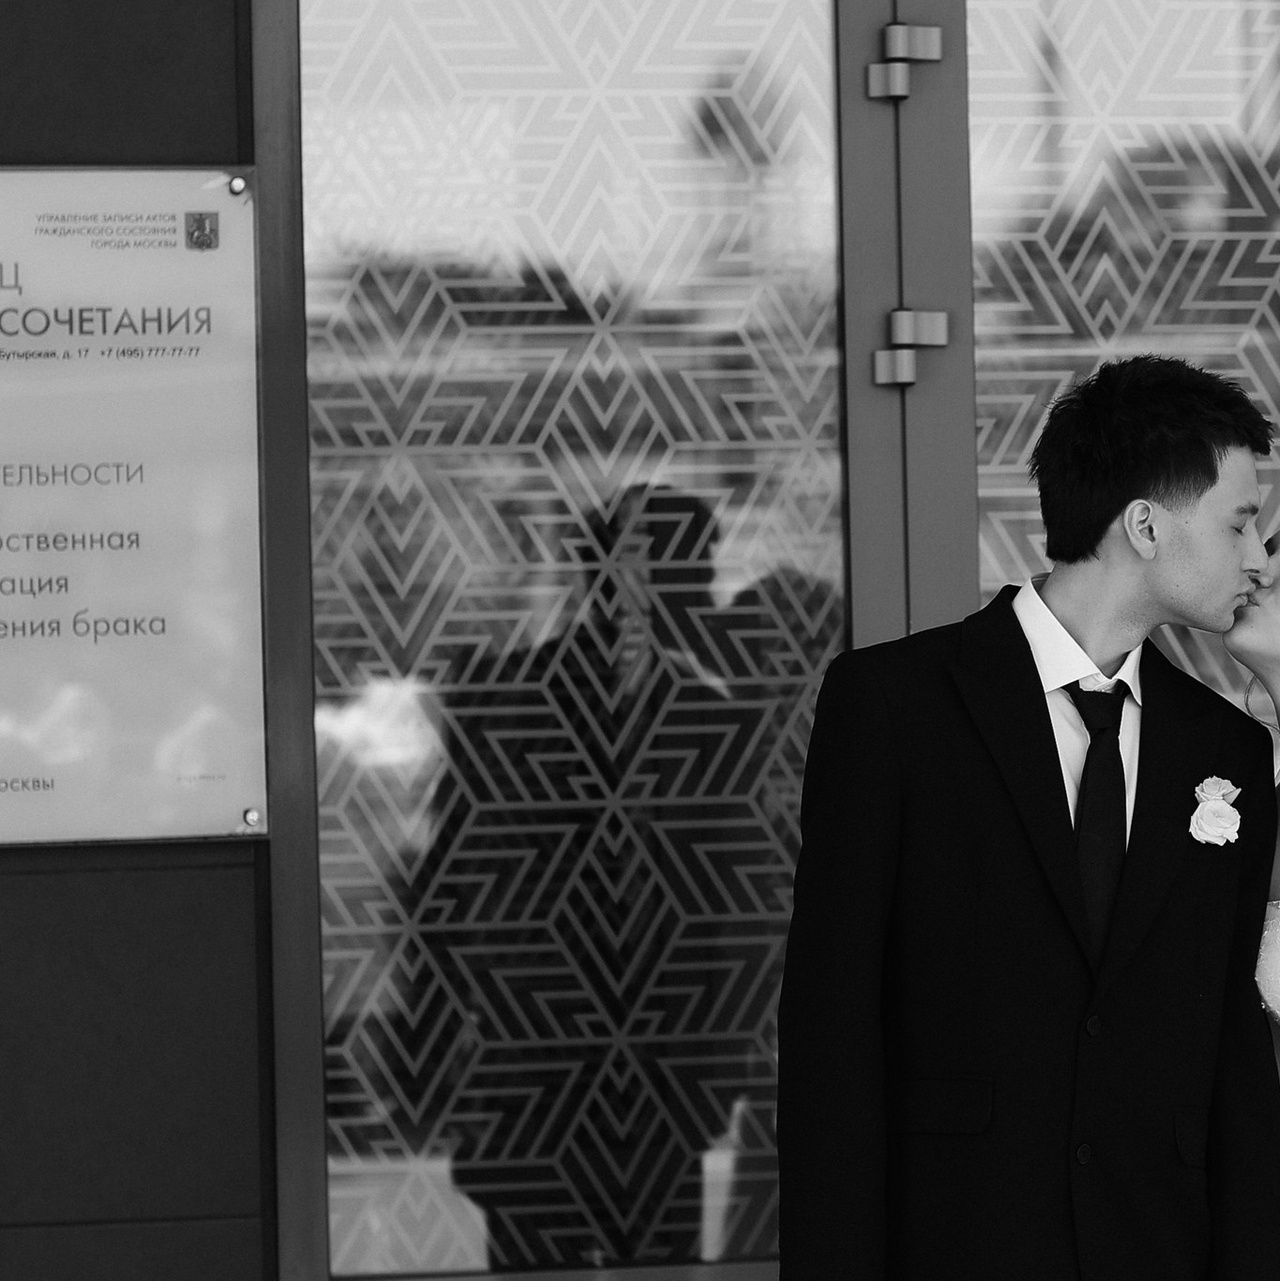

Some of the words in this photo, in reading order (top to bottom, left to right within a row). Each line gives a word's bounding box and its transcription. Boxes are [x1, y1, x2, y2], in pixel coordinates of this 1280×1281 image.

[0, 306, 212, 337] СОЧЕТАНИЯ
[77, 347, 90, 359] 17
[100, 347, 113, 358] +7
[115, 346, 145, 360] (495)
[0, 531, 140, 553] ственная
[73, 607, 166, 644] брака
